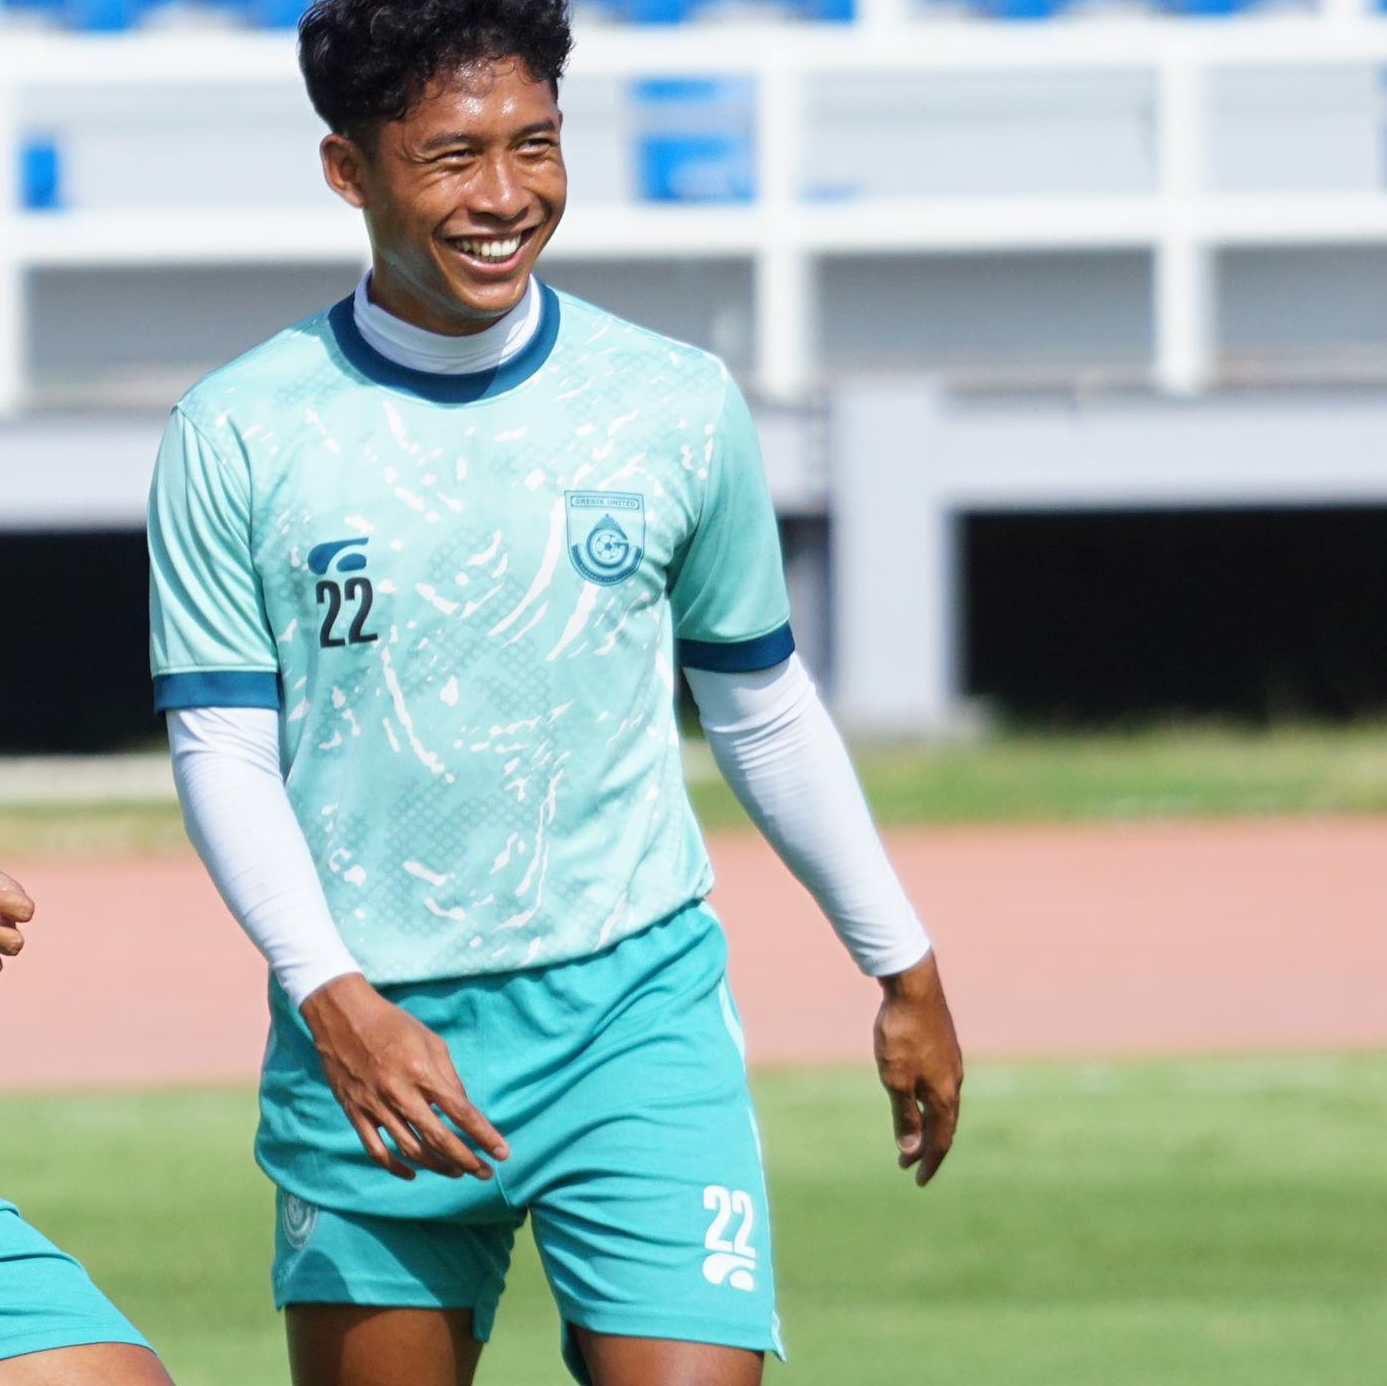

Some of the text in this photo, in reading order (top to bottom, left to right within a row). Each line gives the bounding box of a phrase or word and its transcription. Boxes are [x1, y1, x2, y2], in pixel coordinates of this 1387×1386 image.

[606, 499, 636, 507] UNITED
[315, 577, 378, 649] 22
[702, 1184, 757, 1259] 22
